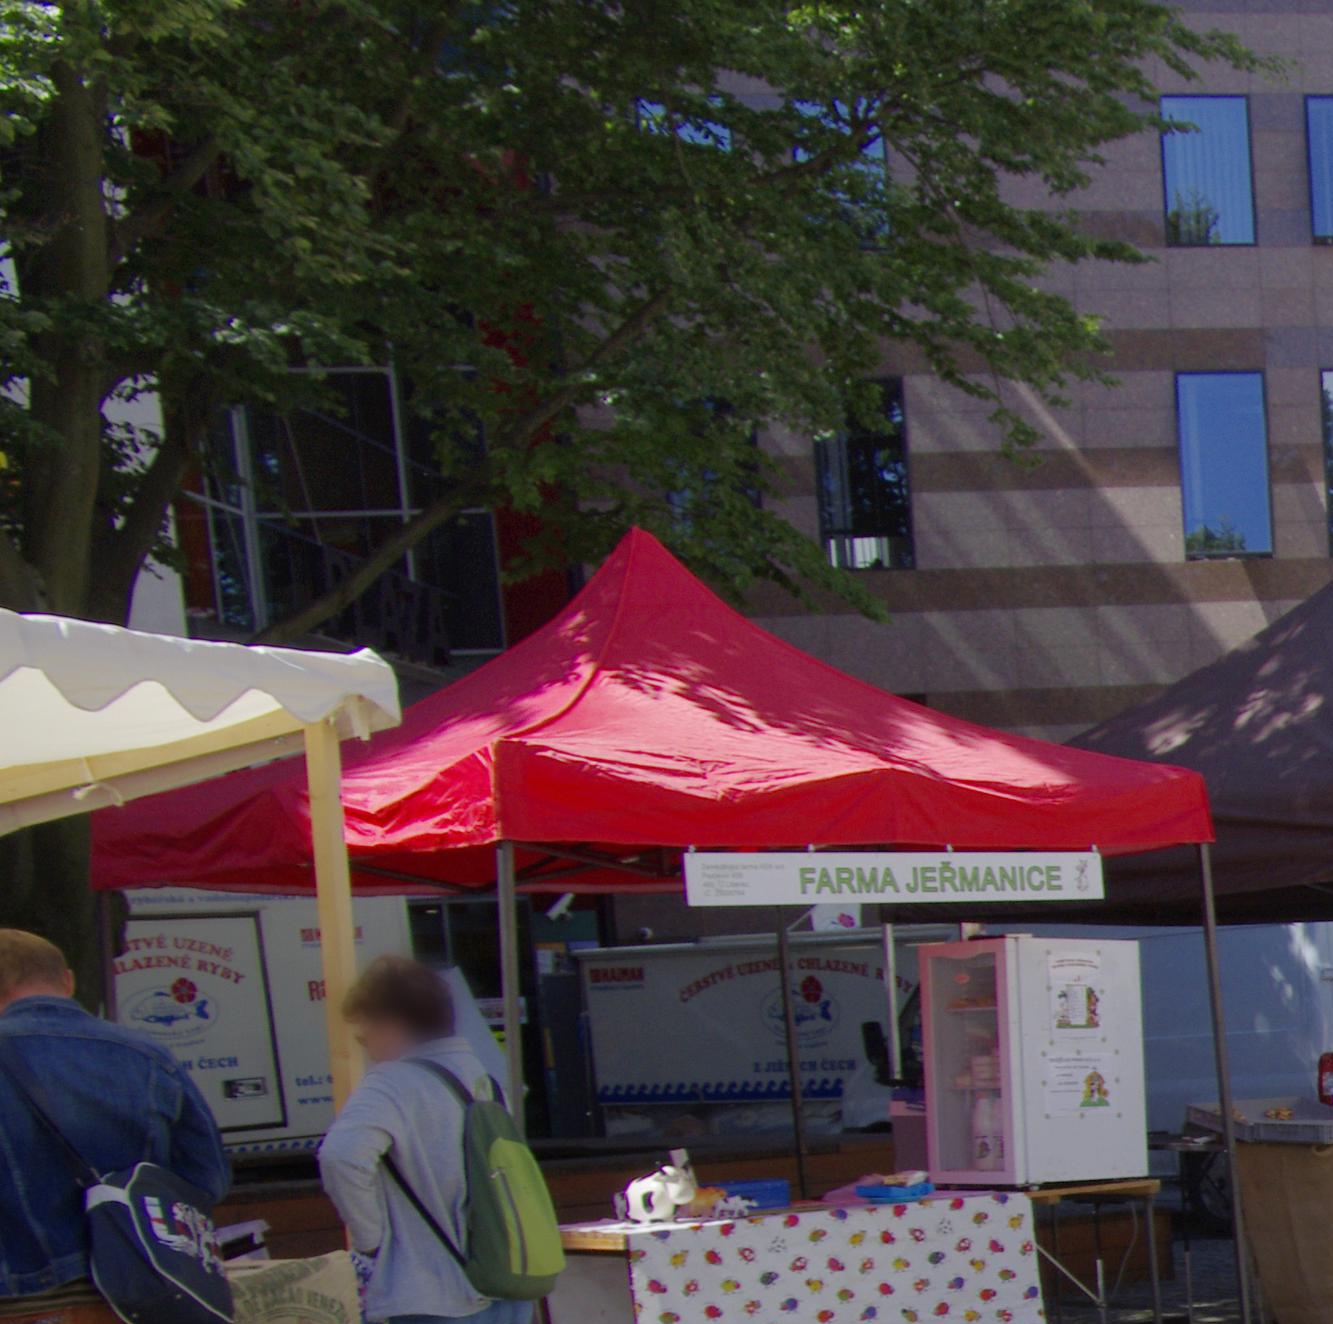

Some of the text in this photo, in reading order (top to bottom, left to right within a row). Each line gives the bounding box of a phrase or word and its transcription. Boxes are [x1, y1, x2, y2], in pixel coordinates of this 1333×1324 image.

[799, 861, 1063, 894] FARMA JEŘMANICE
[174, 937, 234, 961] UZENÉ
[197, 959, 246, 984] RYBY
